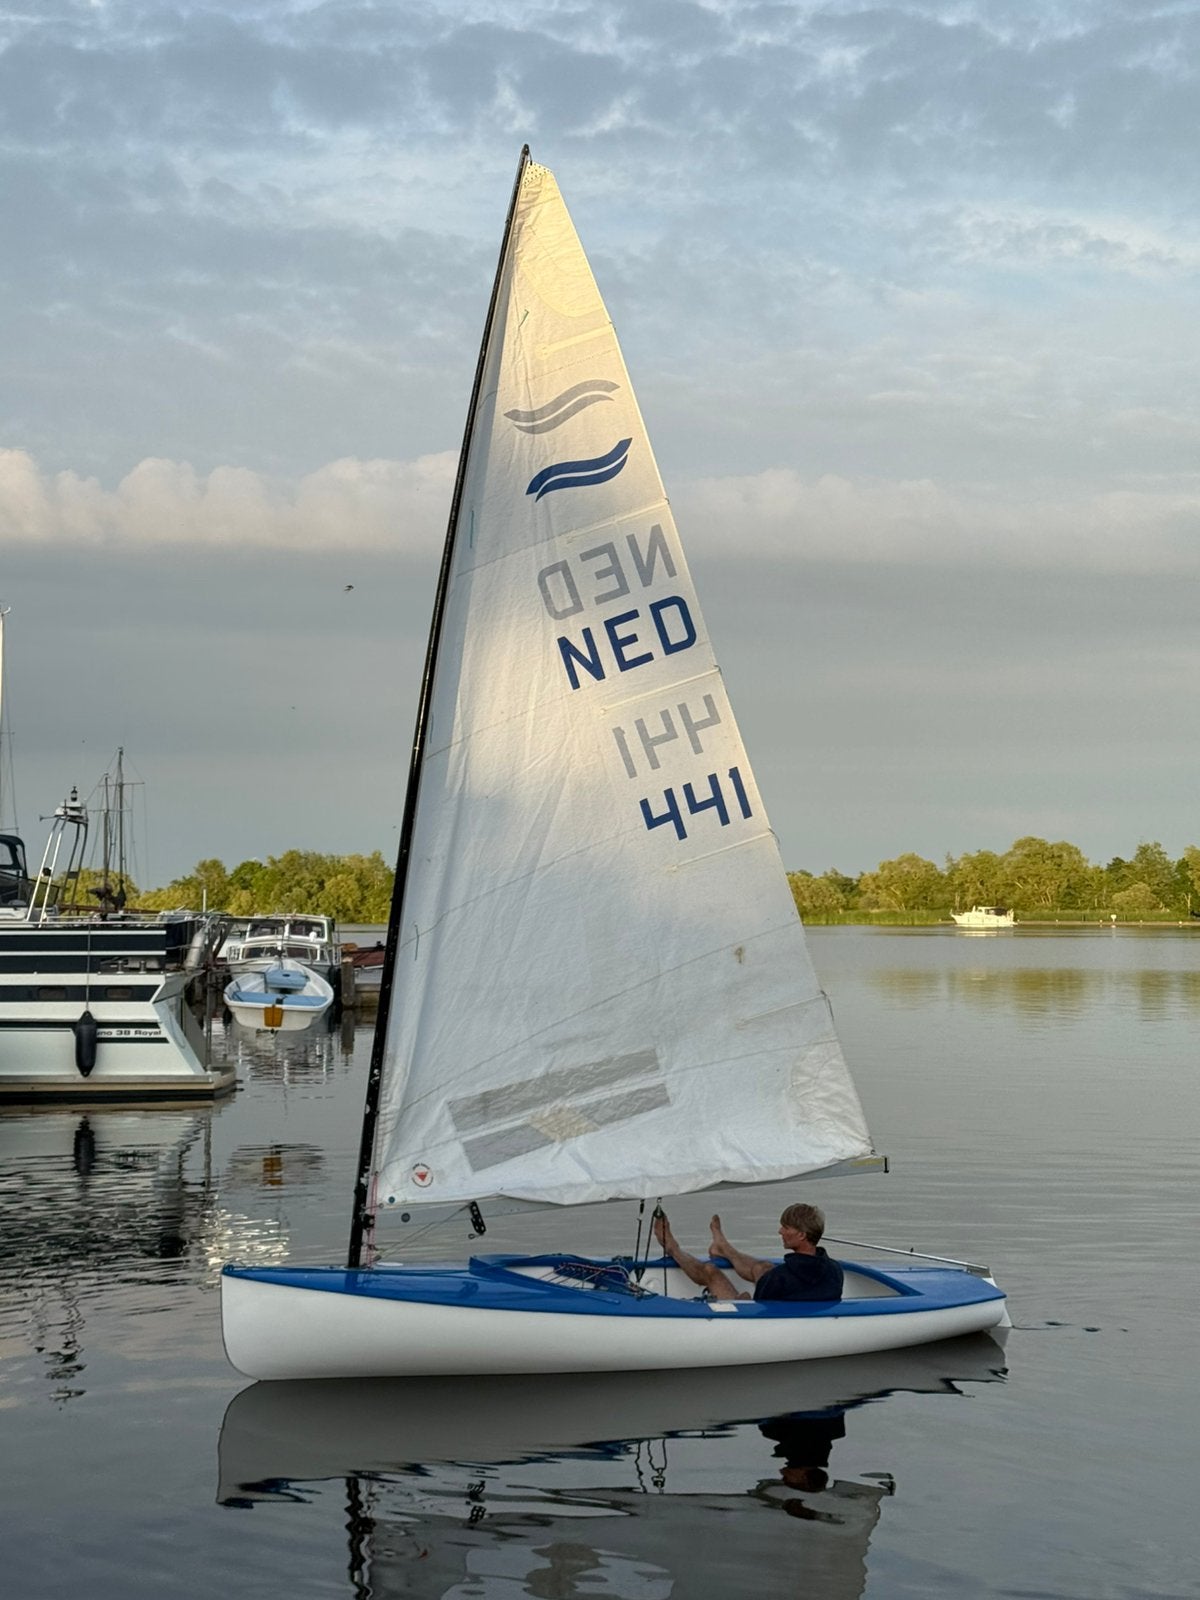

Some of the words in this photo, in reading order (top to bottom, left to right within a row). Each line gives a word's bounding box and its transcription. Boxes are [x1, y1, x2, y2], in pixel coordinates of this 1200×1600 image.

[557, 595, 697, 690] NED
[639, 766, 753, 841] 441
[134, 1029, 162, 1037] Royal
